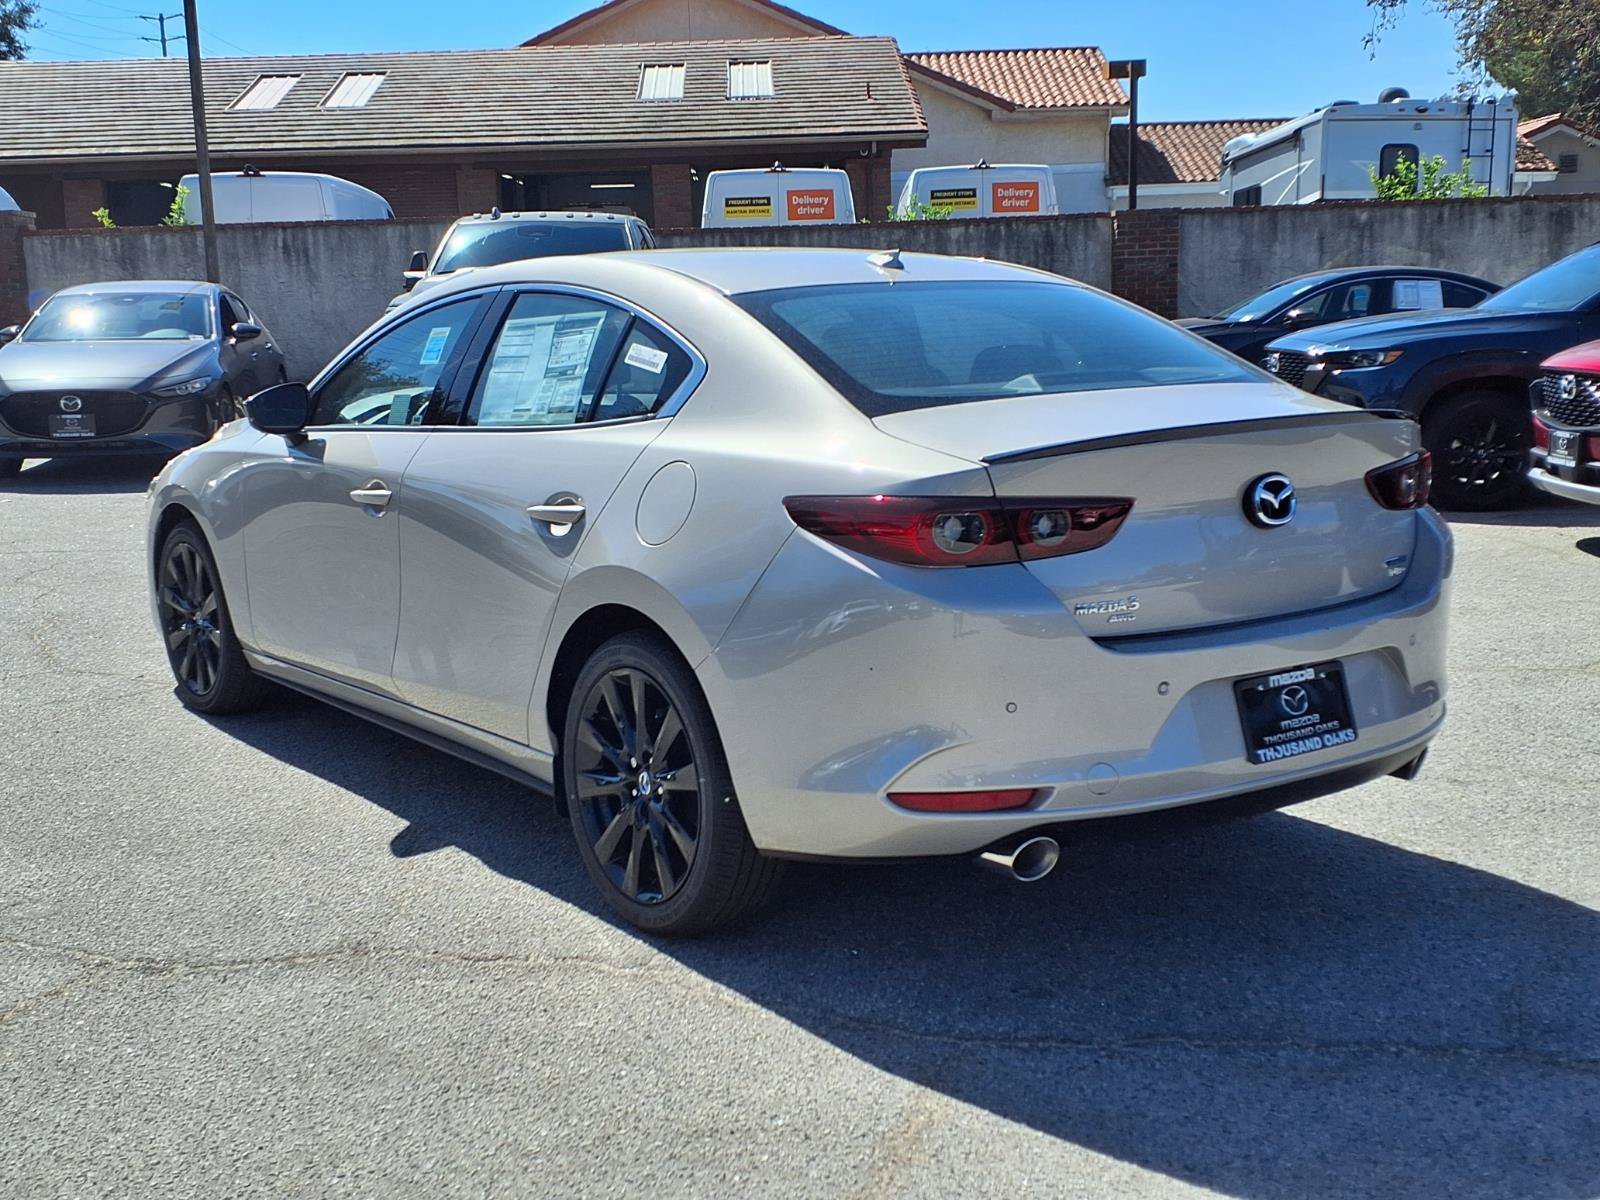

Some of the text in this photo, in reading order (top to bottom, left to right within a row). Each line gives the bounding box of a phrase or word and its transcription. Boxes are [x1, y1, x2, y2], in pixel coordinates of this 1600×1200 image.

[998, 188, 1034, 198] Delivery
[792, 195, 829, 205] Delivery
[1002, 198, 1030, 207] driver
[797, 206, 825, 215] driver
[1075, 595, 1140, 615] MAZDA3
[1263, 720, 1340, 744] THOUSAND OAKS
[1256, 728, 1355, 762] THOUSAND OAKS
